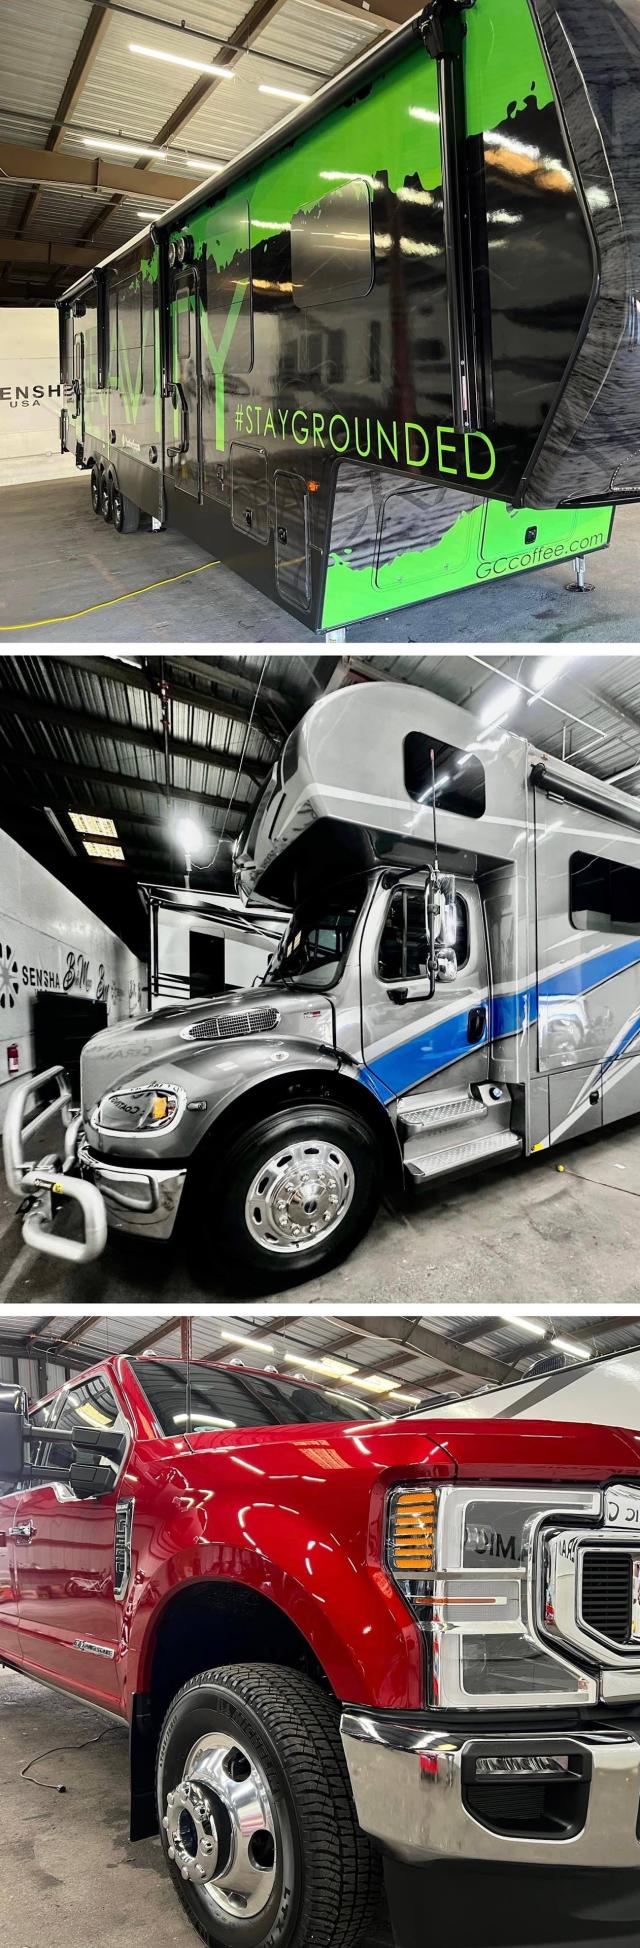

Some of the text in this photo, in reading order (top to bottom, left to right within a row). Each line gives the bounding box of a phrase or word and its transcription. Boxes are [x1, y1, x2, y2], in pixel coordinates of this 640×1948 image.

[10, 400, 40, 408] USA
[235, 404, 496, 480] #STAYGROUNDED
[475, 532, 603, 579] GCcoffee.com
[22, 965, 60, 988] SENSHA
